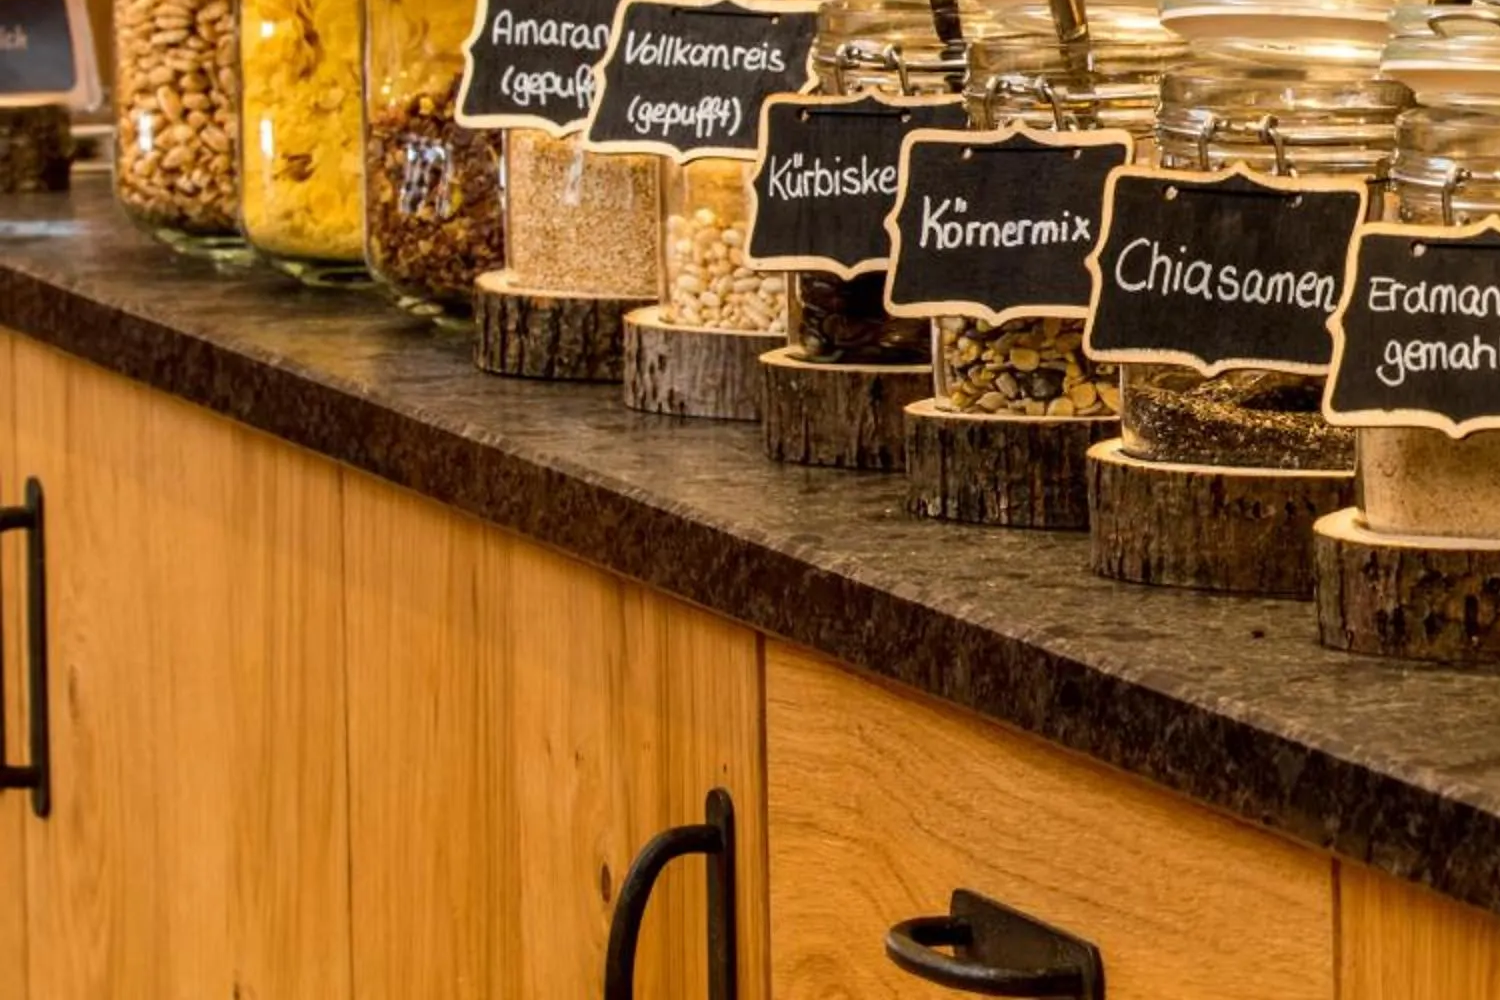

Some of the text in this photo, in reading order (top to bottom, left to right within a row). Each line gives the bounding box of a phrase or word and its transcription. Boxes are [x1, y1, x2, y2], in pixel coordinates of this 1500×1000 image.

[625, 31, 786, 72] Vollkornreis
[627, 95, 741, 138] (gepufft)
[920, 196, 1091, 250] Körnermix
[1115, 237, 1337, 313] Chiasamen
